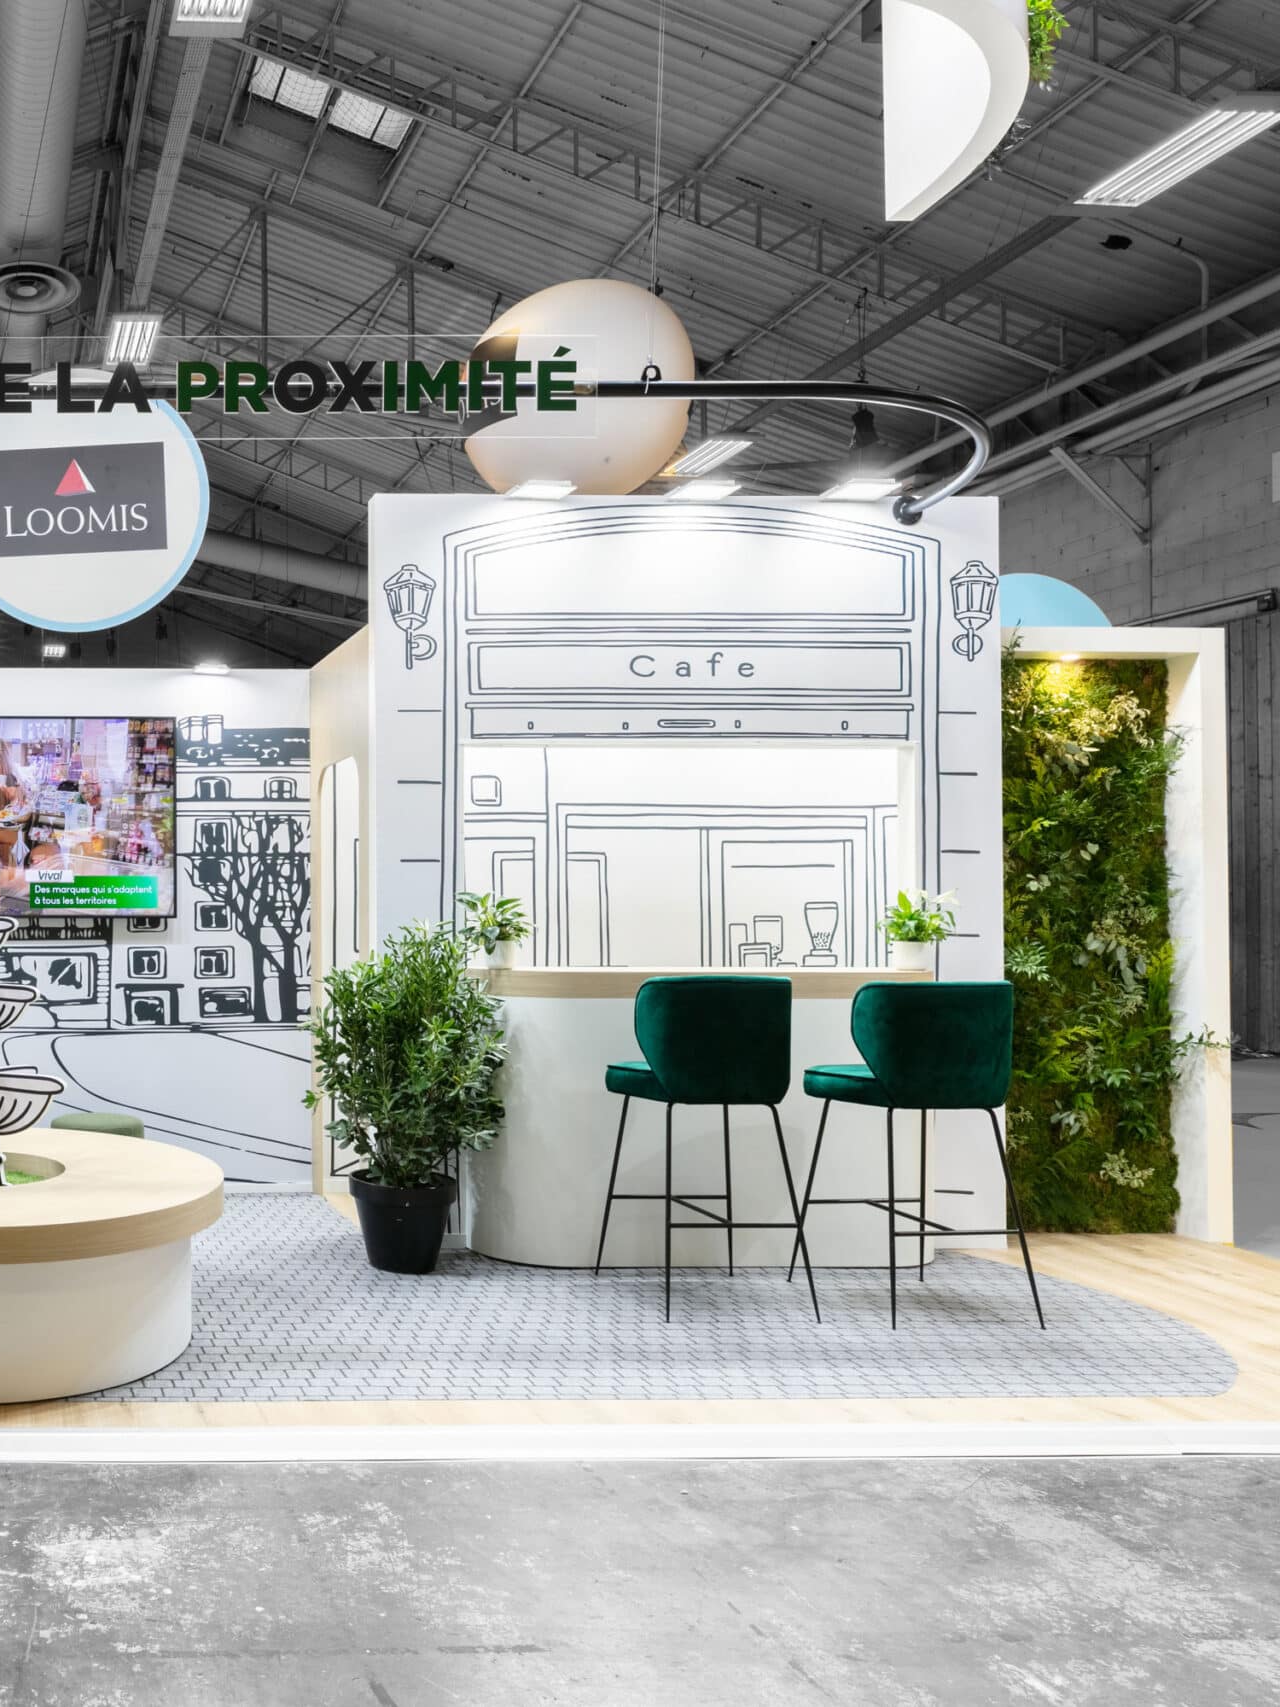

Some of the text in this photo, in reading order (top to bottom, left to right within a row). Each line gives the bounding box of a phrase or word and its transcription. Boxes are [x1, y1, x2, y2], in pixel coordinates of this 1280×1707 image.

[56, 361, 154, 414] LA
[176, 345, 577, 414] PROXIMITÉ
[3, 502, 149, 538] LOOMIS
[629, 652, 755, 678] Cafe
[38, 871, 63, 881] Vival
[34, 885, 152, 895] Des marques qui s'adaptent
[42, 897, 60, 905] tous
[62, 896, 74, 905] les
[76, 896, 117, 905] territoires
